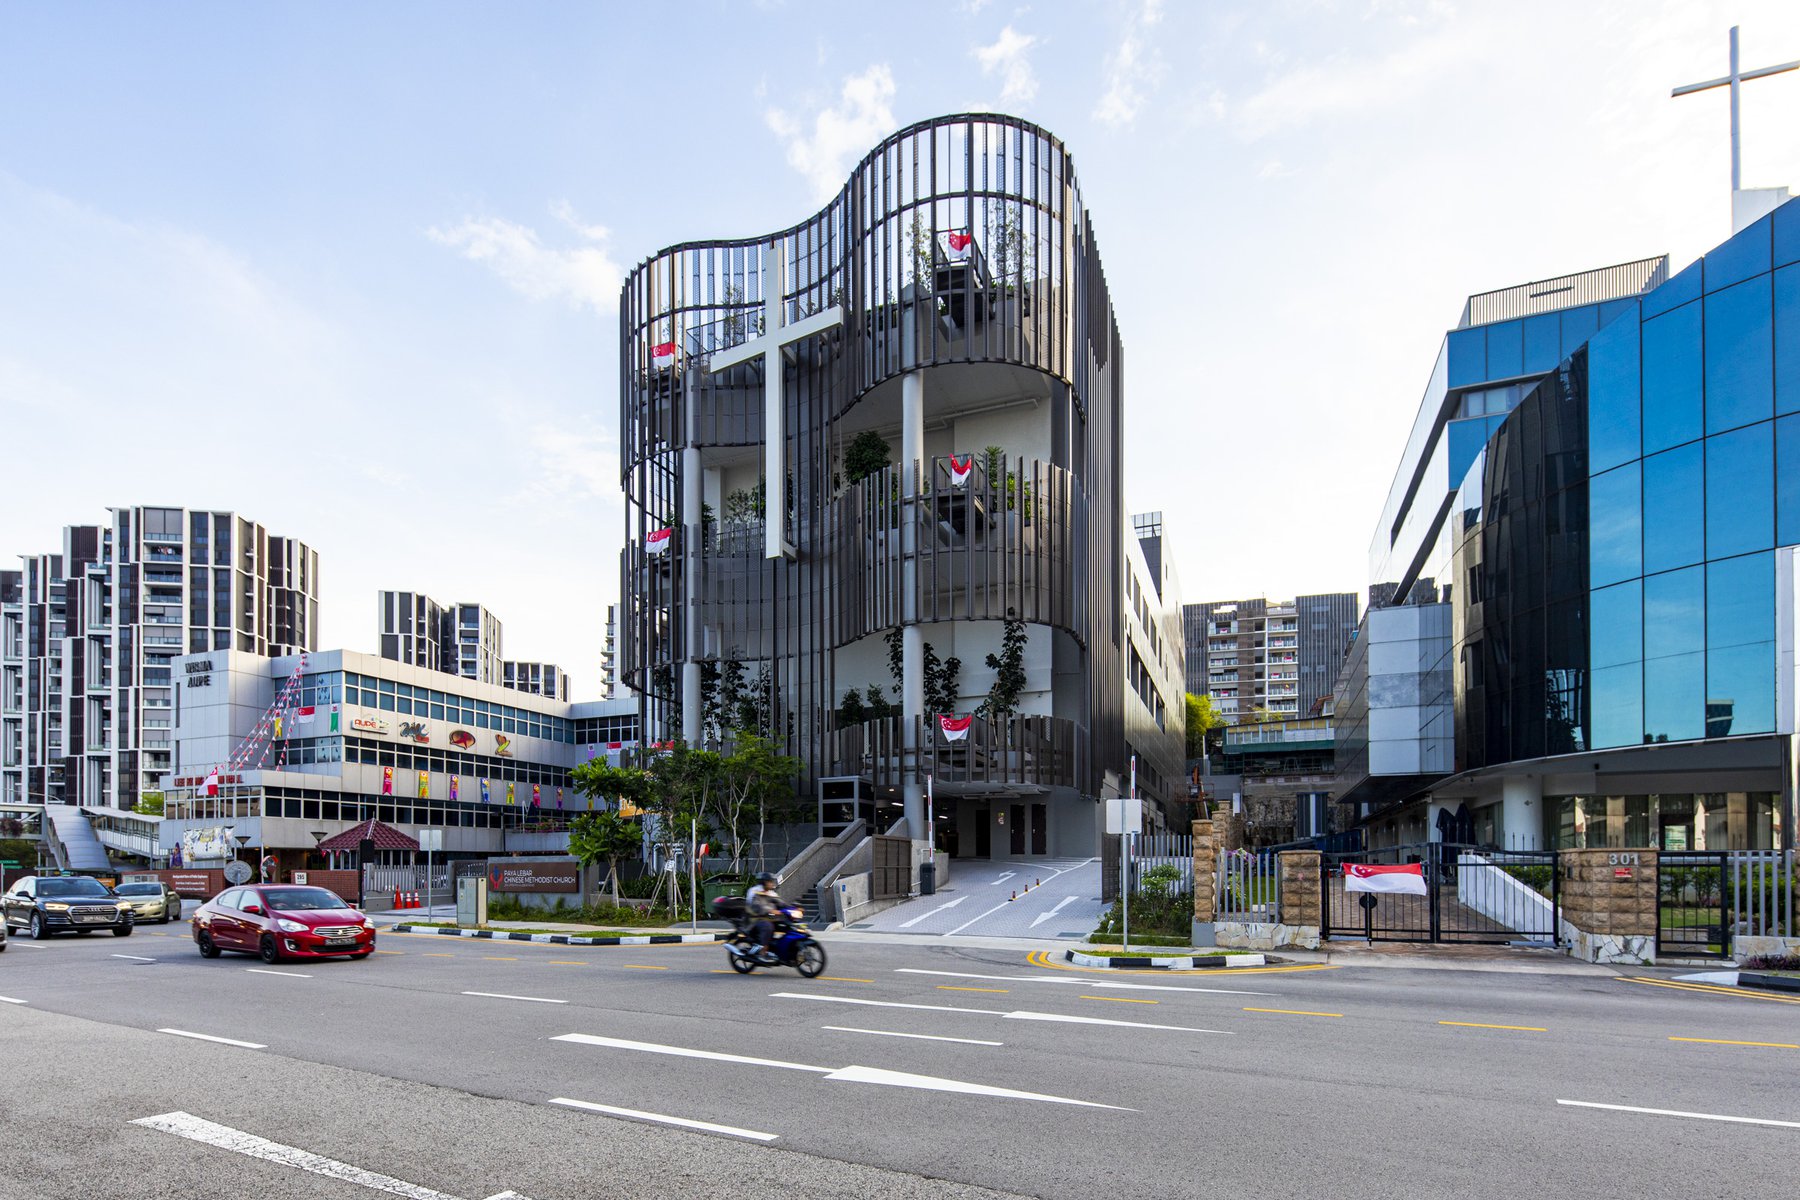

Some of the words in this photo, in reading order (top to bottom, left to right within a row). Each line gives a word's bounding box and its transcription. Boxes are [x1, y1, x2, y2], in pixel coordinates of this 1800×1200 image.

[187, 675, 211, 688] AUPE
[354, 719, 376, 728] AUPE
[1609, 853, 1639, 865] 301
